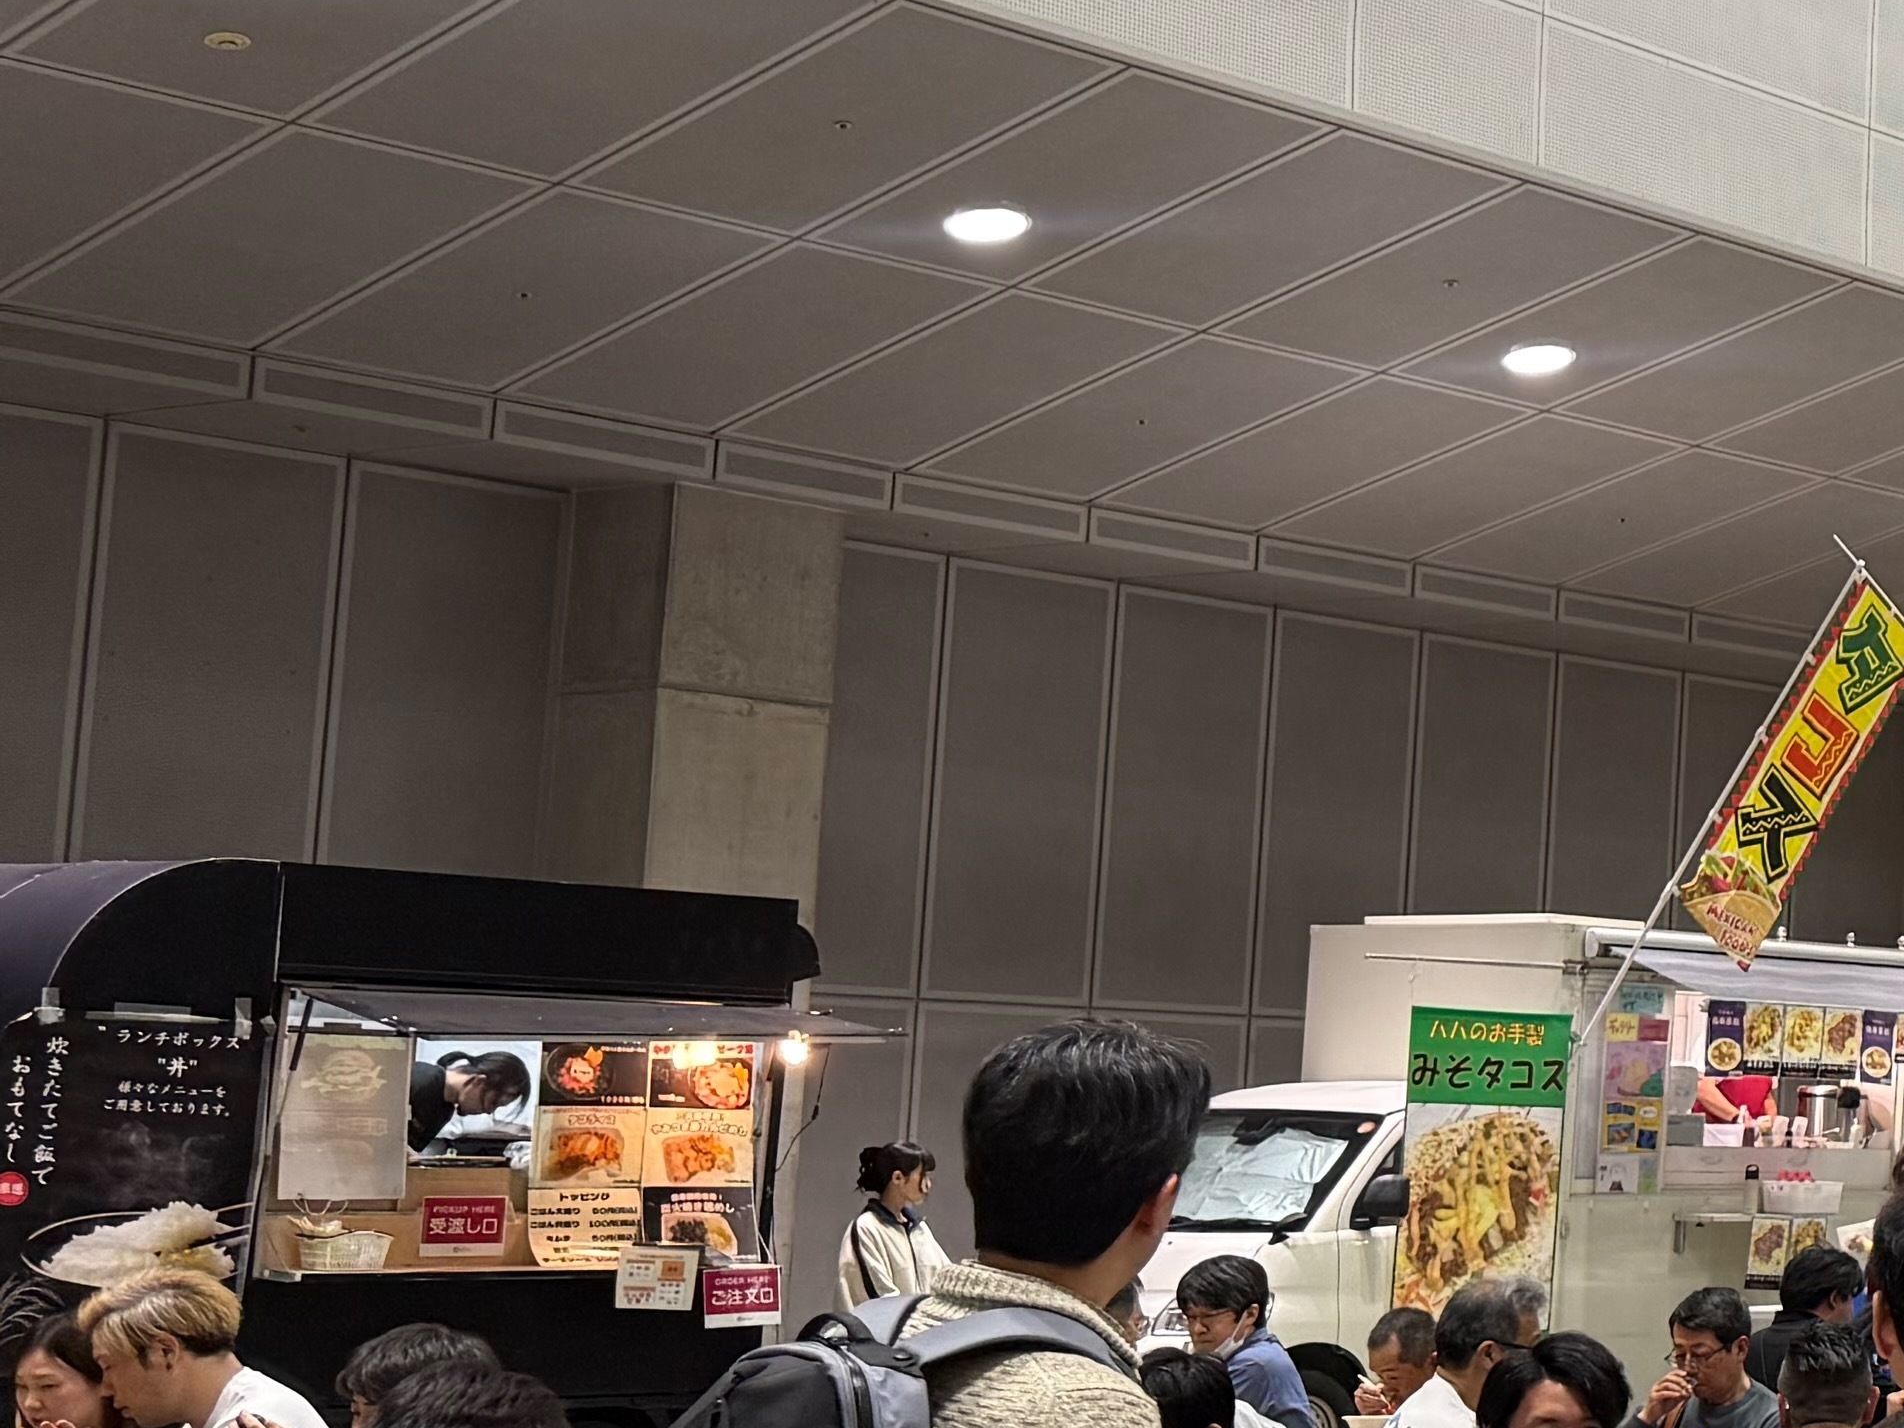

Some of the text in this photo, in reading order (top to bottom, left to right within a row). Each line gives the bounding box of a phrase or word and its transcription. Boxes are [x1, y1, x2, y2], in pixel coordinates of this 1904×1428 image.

[1735, 603, 1904, 885] タコス
[1430, 1020, 1545, 1046] ハハのお手製
[1411, 1053, 1565, 1091] みそタコス
[118, 1080, 226, 1098] 様々なメニューを
[4, 1055, 32, 1163] おもてなし
[429, 1218, 498, 1235] 受渡し口
[712, 1288, 774, 1306] ご注文口
